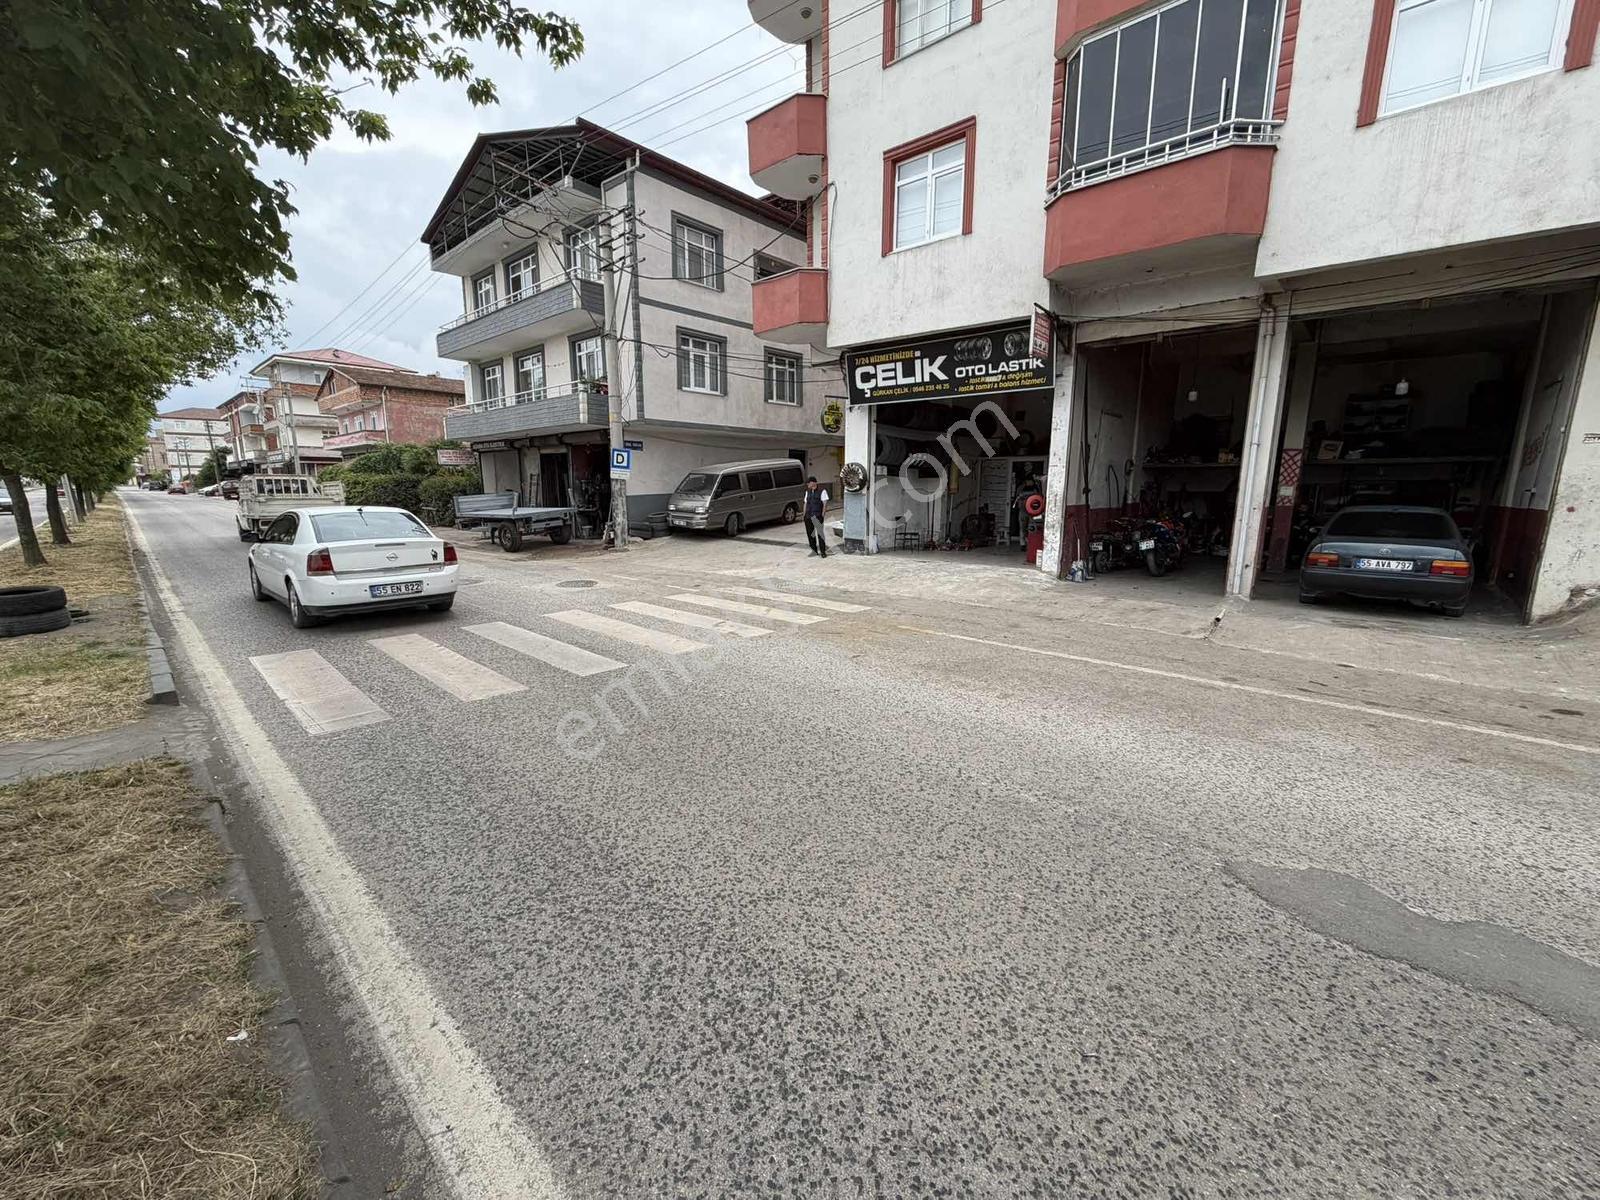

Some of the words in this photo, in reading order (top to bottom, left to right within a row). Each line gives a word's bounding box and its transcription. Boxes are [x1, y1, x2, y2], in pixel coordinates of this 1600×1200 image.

[855, 357, 869, 366] 7/24
[955, 364, 986, 378] OTO
[988, 355, 1046, 374] LASTİK
[855, 350, 949, 398] ÇELİK
[616, 453, 625, 464] D
[1361, 559, 1372, 567] 55
[1394, 561, 1412, 570] 797
[376, 586, 388, 595] 55
[391, 585, 402, 594] EN
